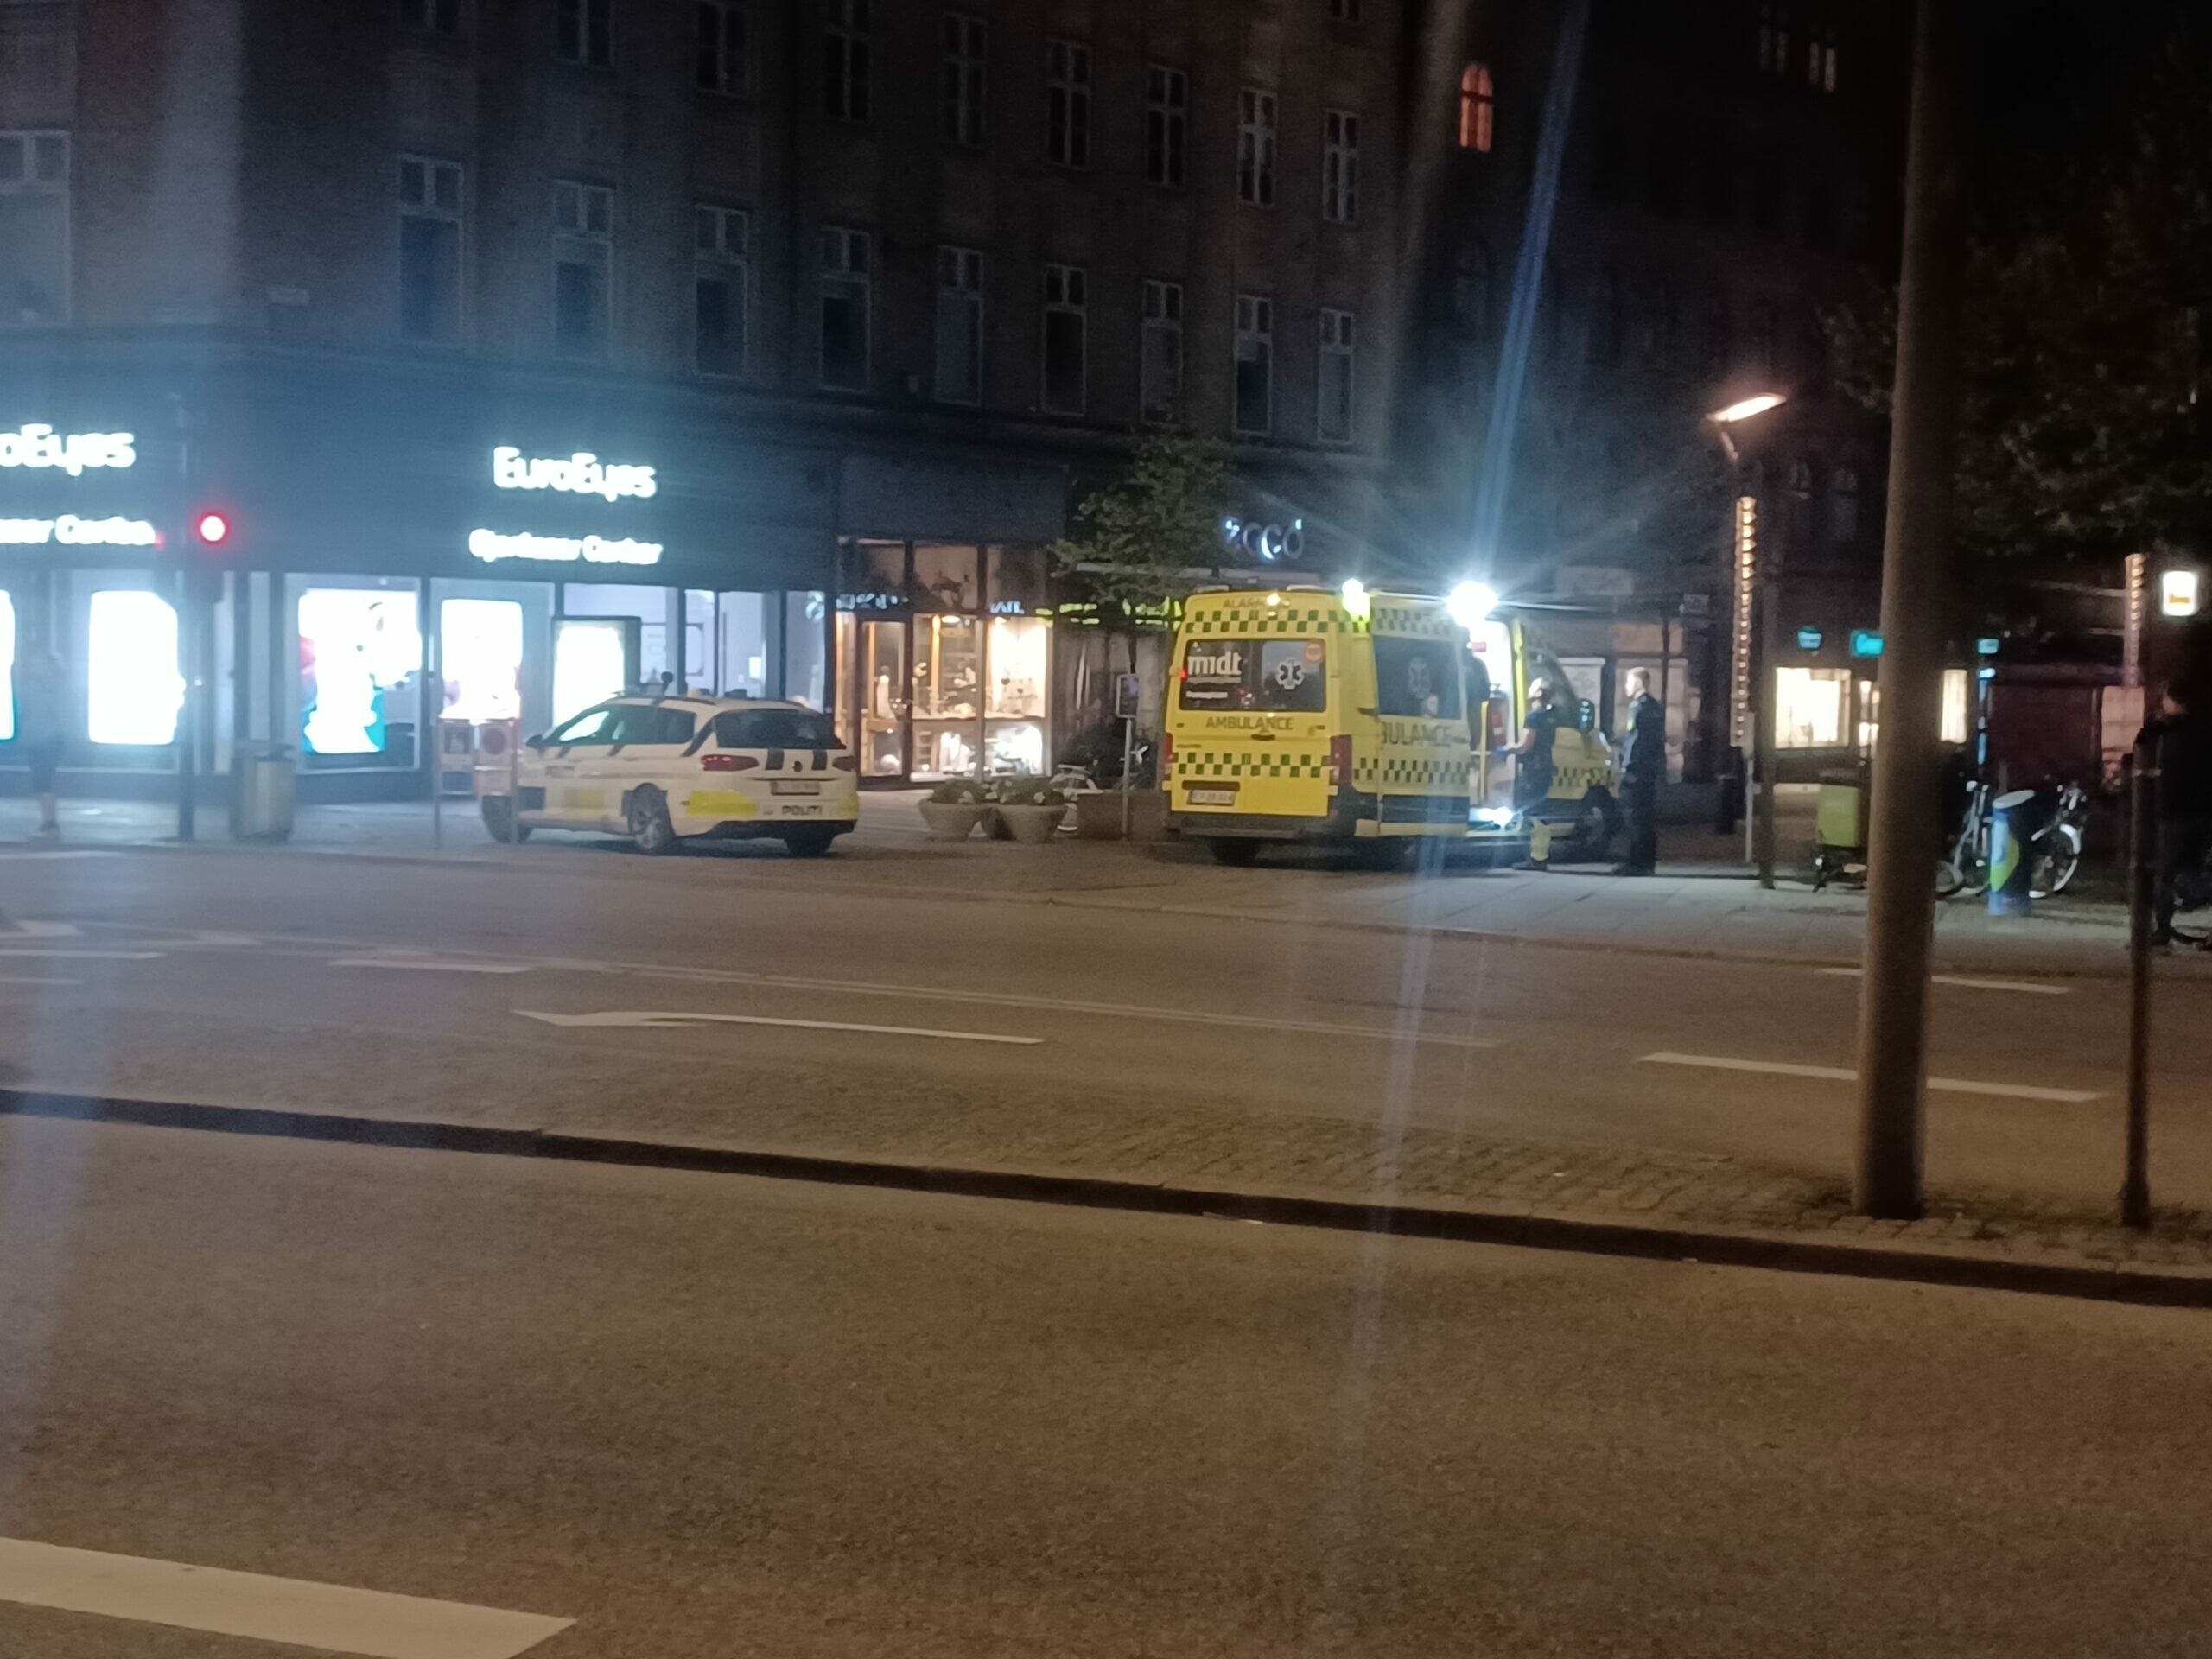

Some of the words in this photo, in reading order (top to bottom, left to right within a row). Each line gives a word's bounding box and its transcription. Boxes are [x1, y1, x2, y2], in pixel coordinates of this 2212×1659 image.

[494, 447, 655, 501] EuroEyes
[1188, 651, 1242, 675] mdt
[1205, 716, 1294, 730] AMBULANCE
[781, 804, 823, 816] POLITI
